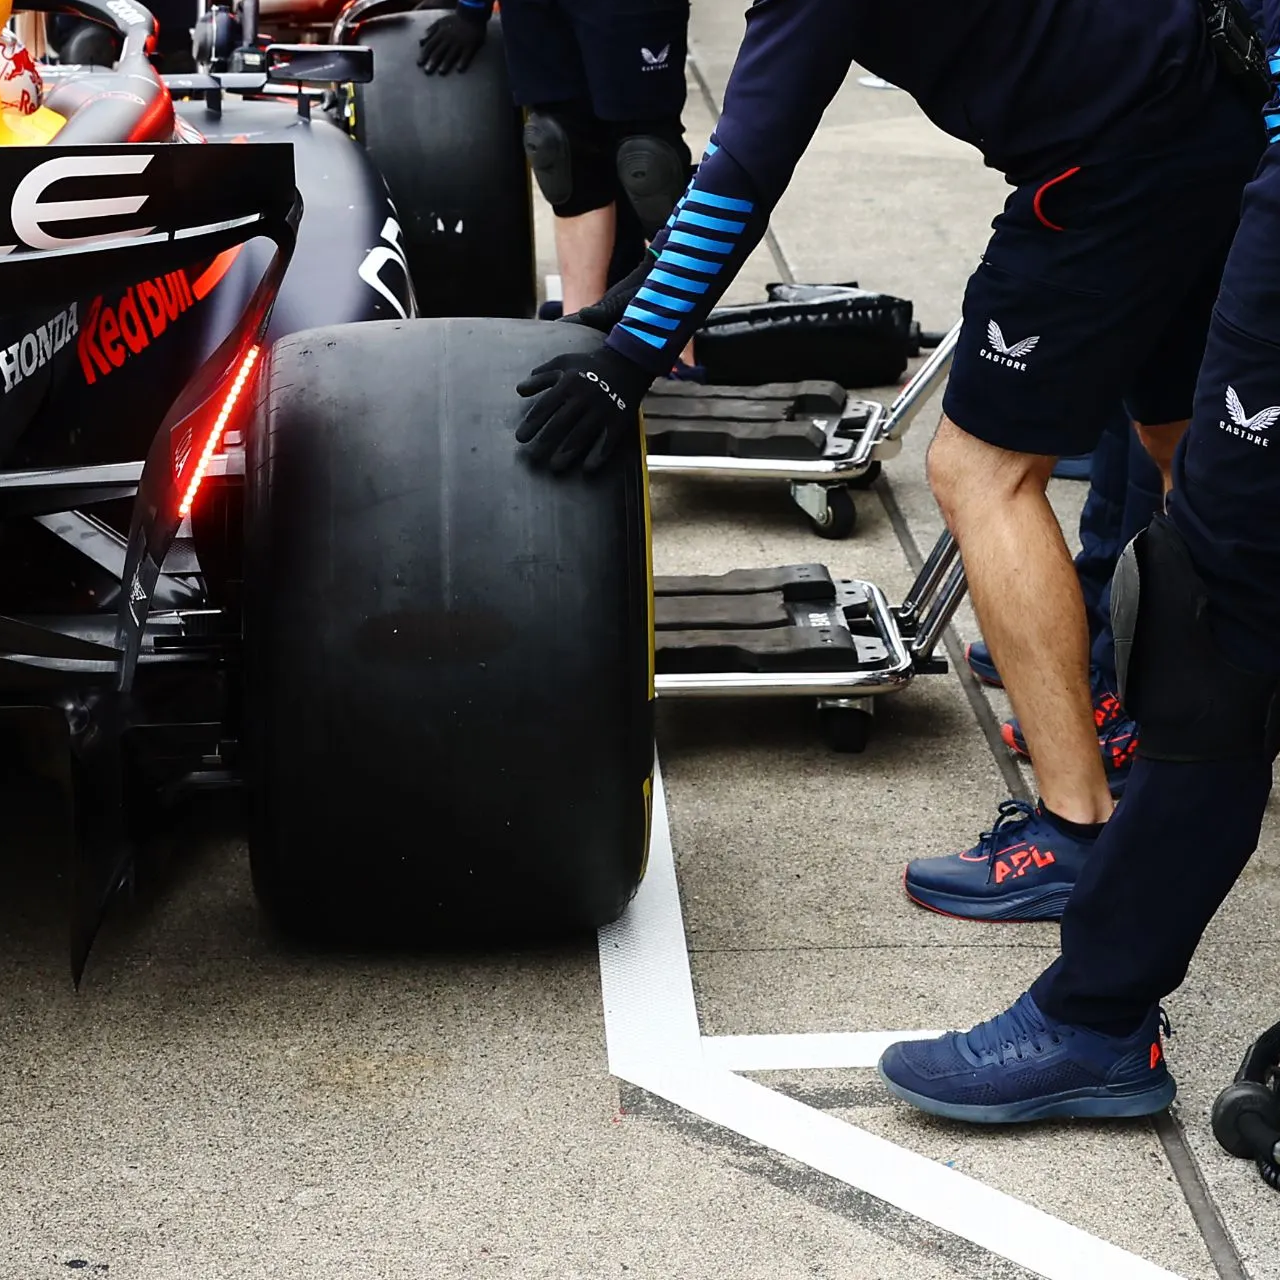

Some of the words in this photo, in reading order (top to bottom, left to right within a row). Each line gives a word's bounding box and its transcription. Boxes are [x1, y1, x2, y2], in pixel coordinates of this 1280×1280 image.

[77, 286, 150, 386] Red
[136, 269, 195, 339] Bull
[979, 348, 1028, 372] CASTORE
[1219, 420, 1270, 448] CASTORE
